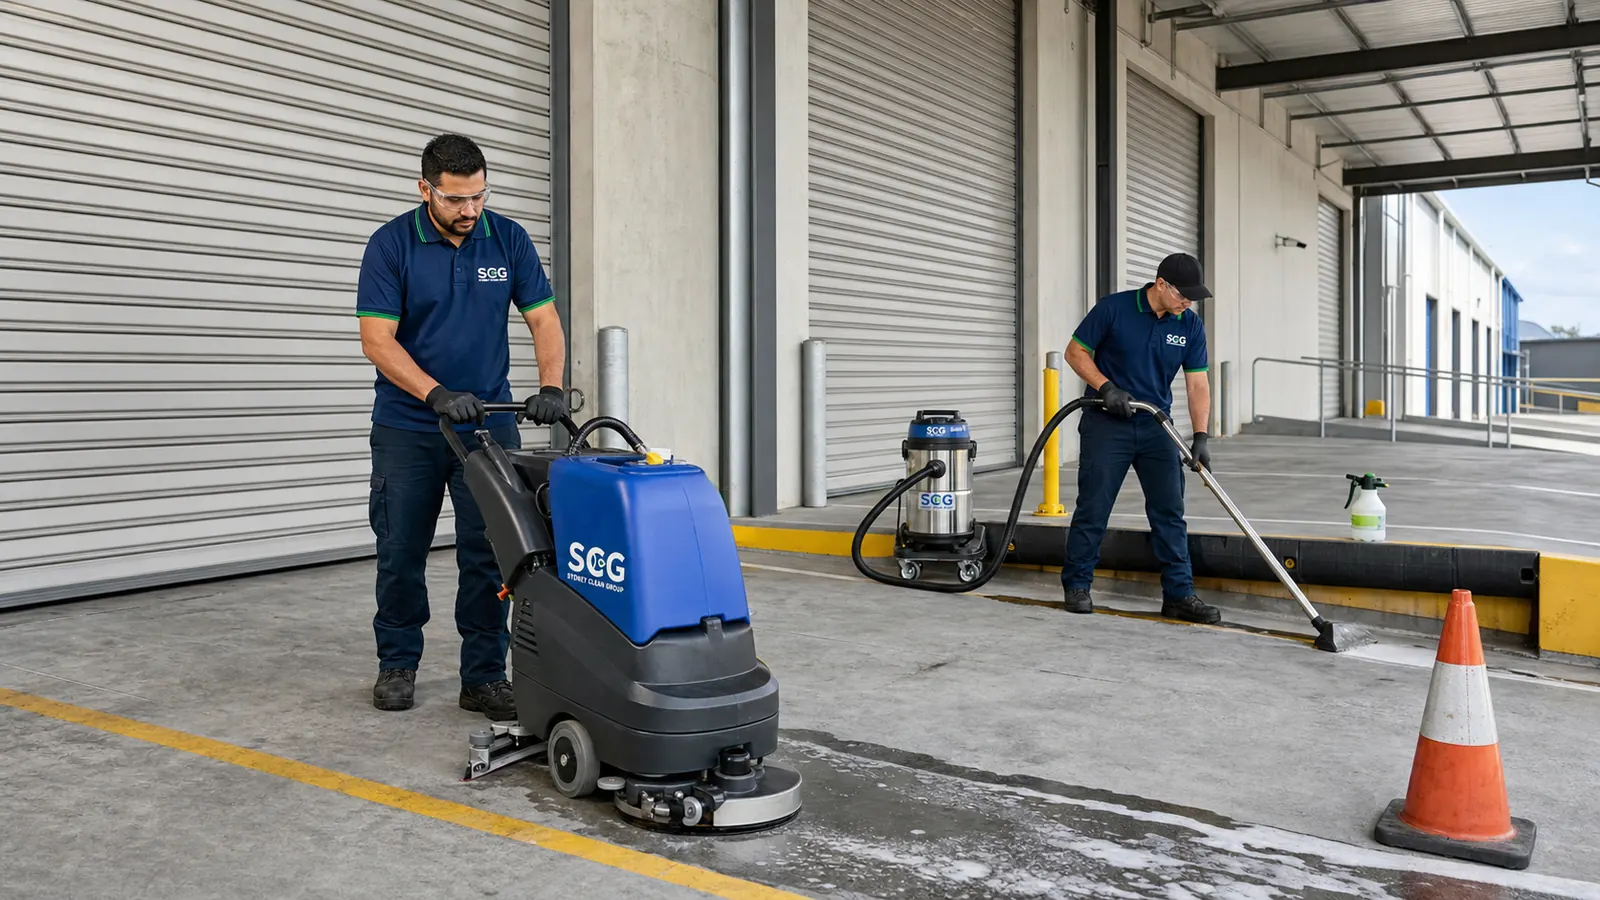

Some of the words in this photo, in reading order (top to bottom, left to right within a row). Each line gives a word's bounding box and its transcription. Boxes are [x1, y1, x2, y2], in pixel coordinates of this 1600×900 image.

[477, 267, 508, 279] SCG
[1166, 333, 1187, 345] SCG
[926, 426, 946, 435] SCG
[921, 493, 953, 506] SCG
[568, 541, 625, 583] SCG
